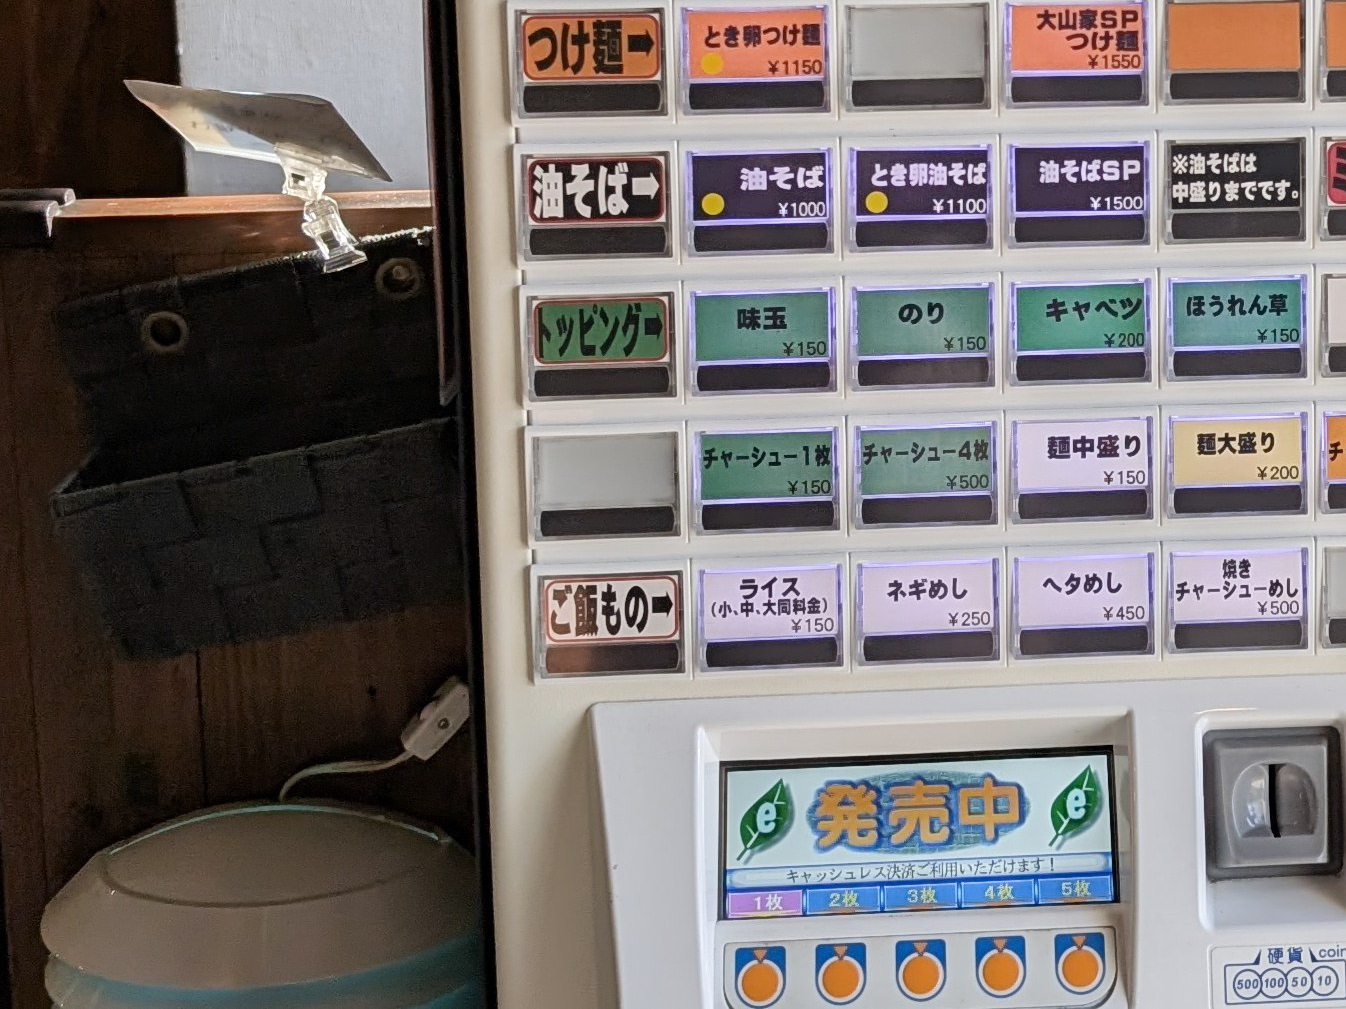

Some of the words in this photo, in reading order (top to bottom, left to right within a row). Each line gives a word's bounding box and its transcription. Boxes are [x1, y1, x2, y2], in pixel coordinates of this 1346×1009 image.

[1036, 9, 1138, 30] 大山家SP
[528, 19, 624, 75] つけ麺
[704, 24, 821, 48] とき卵つけ麺
[1065, 31, 1139, 52] つけ麺
[768, 59, 822, 76] ¥1150
[1087, 54, 1141, 69] ¥1550
[1039, 160, 1141, 184] 油そばSP
[1173, 152, 1257, 174] ※油そばは
[740, 167, 823, 191] 油そば
[871, 163, 986, 187] とき卵油そば
[533, 162, 630, 219] 油そば
[1173, 180, 1299, 203] 中盛りまでです。
[778, 201, 826, 217] ¥1000
[932, 198, 986, 214] ¥1100
[1090, 195, 1143, 211] ¥1500
[898, 302, 944, 325] のり
[1046, 297, 1143, 321] キャベツ
[1186, 294, 1288, 317] ほうれん草
[736, 307, 788, 330] 味玉
[537, 302, 642, 358] トッピング
[1103, 332, 1144, 347] ¥200
[1257, 328, 1299, 343] ¥150
[783, 341, 827, 356] ¥150
[944, 335, 986, 351] ¥150
[863, 440, 989, 466] チャーシュー4枚
[1047, 436, 1142, 459] 麺中盛り
[1197, 432, 1275, 455] 麺大盛り
[703, 445, 830, 469] チャーシュー1枚
[946, 475, 988, 489] ¥500
[1103, 470, 1146, 485] ¥150
[1257, 465, 1299, 480] ¥200
[788, 480, 830, 494] ¥150
[1222, 558, 1251, 579] 焼き
[740, 577, 801, 599] ライス
[888, 578, 967, 602] ネギめし
[1043, 572, 1123, 594] ヘタめし
[1175, 578, 1299, 601] チャーシューめし
[550, 583, 649, 637] ご飯もの
[1103, 605, 1145, 621] ¥450
[1257, 600, 1299, 615] ¥500
[791, 618, 834, 632] ¥150
[948, 612, 990, 626] ¥250
[816, 774, 1022, 848] 発売中
[829, 891, 858, 908] 2枚
[985, 884, 1014, 901] 4枚
[1237, 978, 1258, 990] 500
[1264, 977, 1285, 989] 100
[1292, 976, 1308, 987] 50
[1318, 975, 1331, 987] 10
